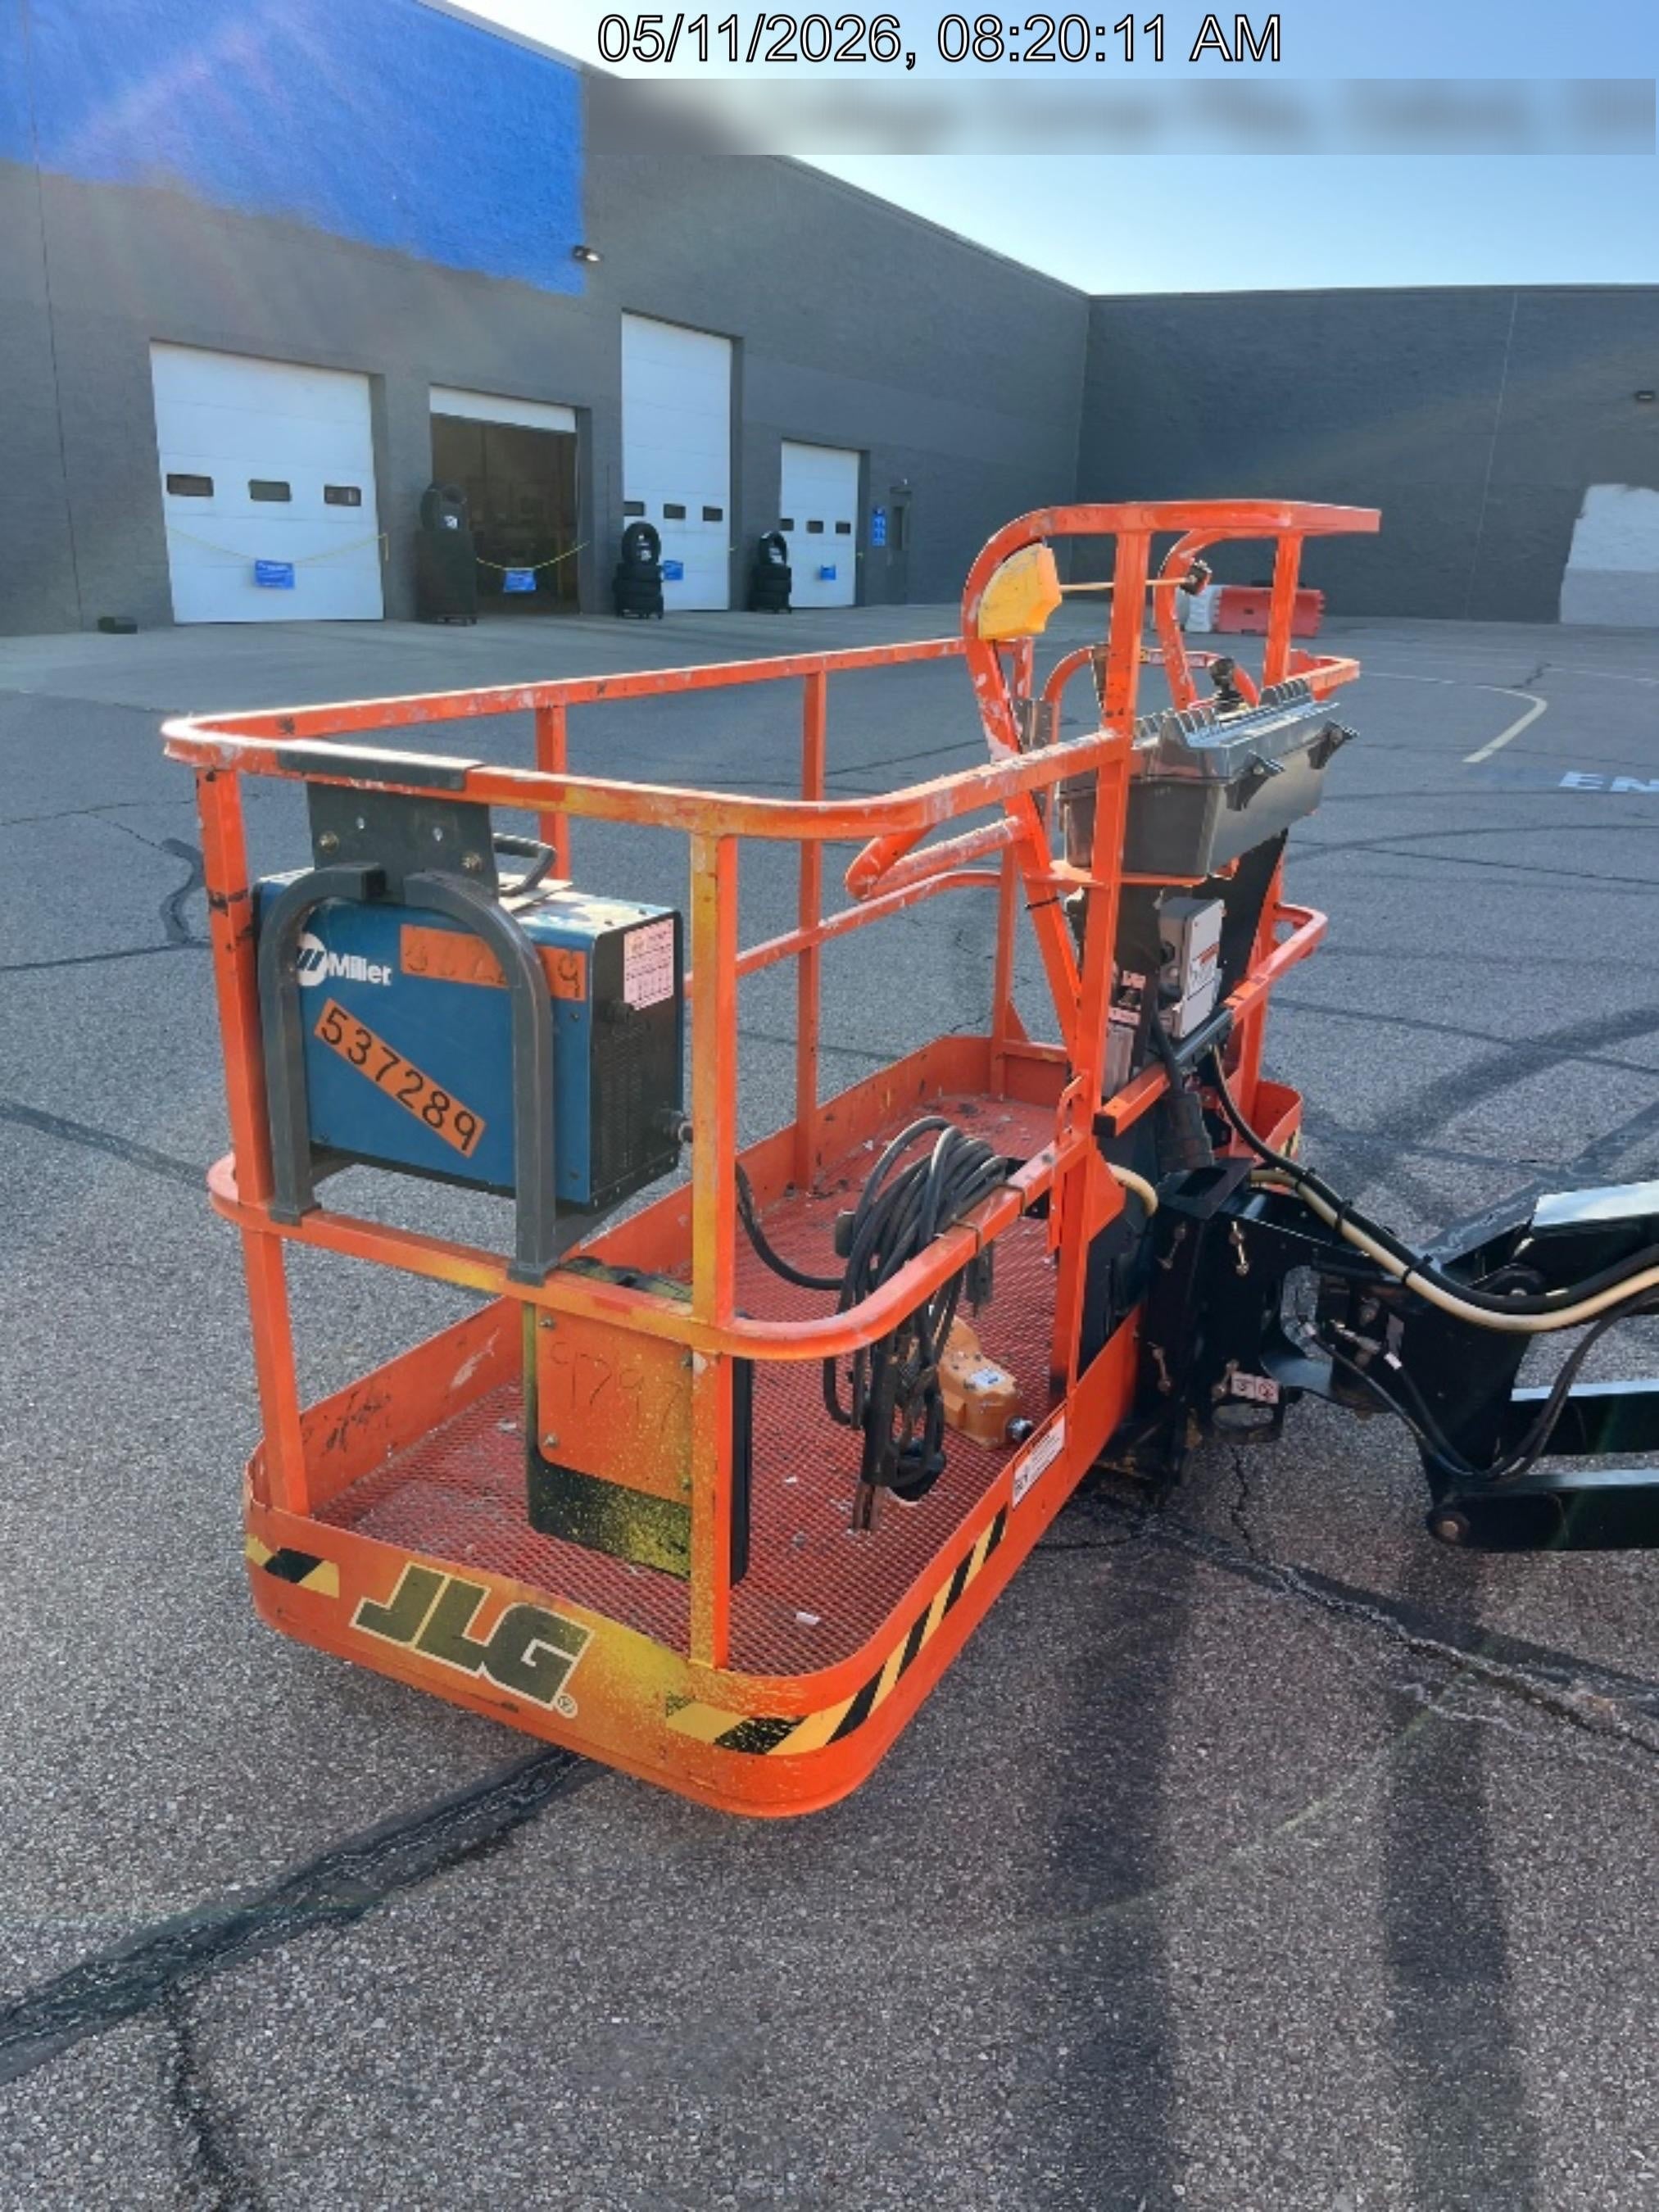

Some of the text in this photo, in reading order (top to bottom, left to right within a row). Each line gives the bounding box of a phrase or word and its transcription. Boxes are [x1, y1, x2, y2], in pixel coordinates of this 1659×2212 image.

[329, 950, 392, 986] Miller
[320, 1007, 478, 1153] 537289
[350, 1561, 593, 1711] JLG
